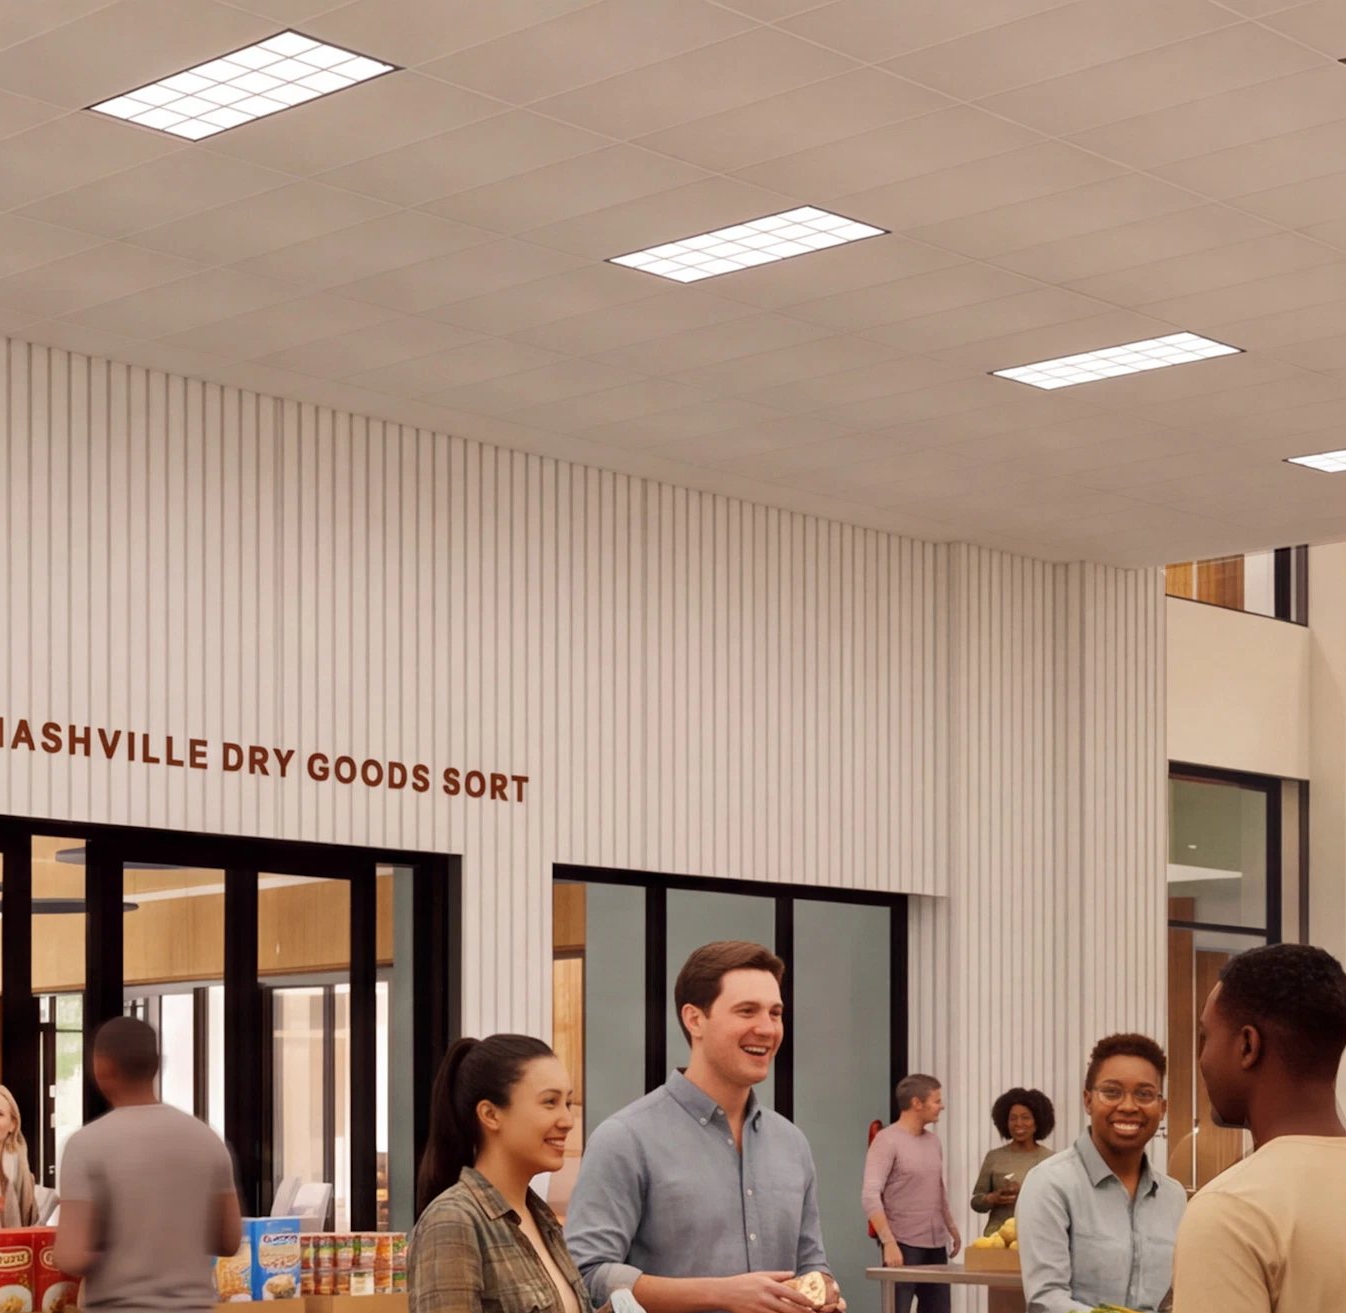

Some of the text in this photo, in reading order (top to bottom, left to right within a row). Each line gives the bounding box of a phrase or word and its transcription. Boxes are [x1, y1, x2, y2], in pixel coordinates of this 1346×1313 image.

[222, 741, 296, 778] DRY
[306, 751, 430, 793] GOODS
[442, 767, 530, 803] SORT
